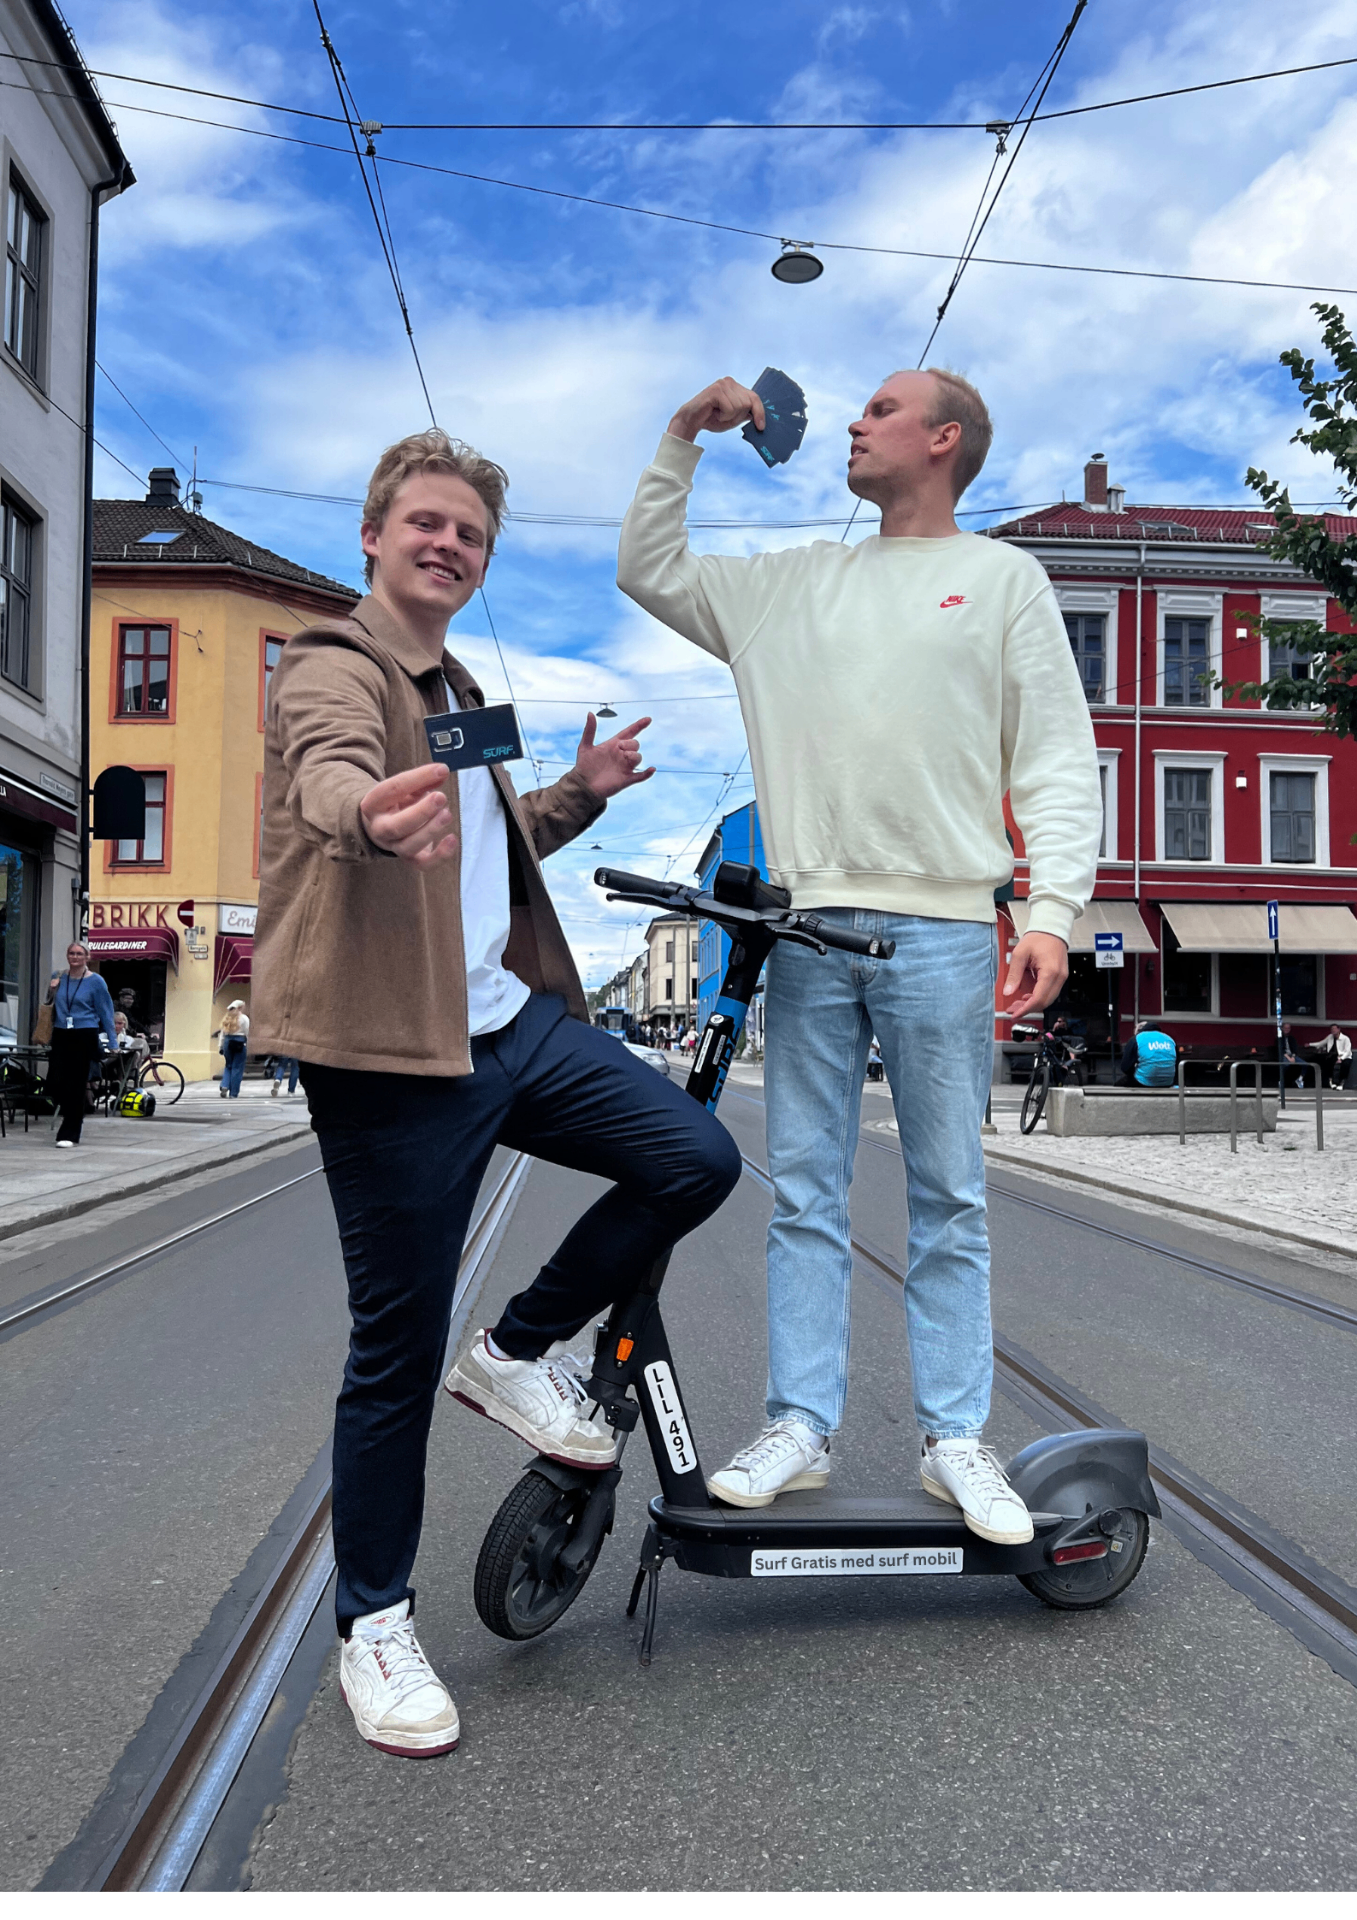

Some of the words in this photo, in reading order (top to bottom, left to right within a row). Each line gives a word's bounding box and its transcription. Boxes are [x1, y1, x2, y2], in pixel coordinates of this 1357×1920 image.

[93, 904, 170, 928] BRIKK
[88, 941, 147, 950] RULLEGARDINER
[1148, 1041, 1171, 1050] Wolt
[652, 1368, 674, 1414] LIL
[668, 1420, 690, 1467] 491
[755, 1557, 787, 1570] Surf
[791, 1555, 837, 1569] Gratis
[841, 1554, 874, 1568] med
[878, 1553, 909, 1567] surf
[913, 1552, 957, 1566] mobil
